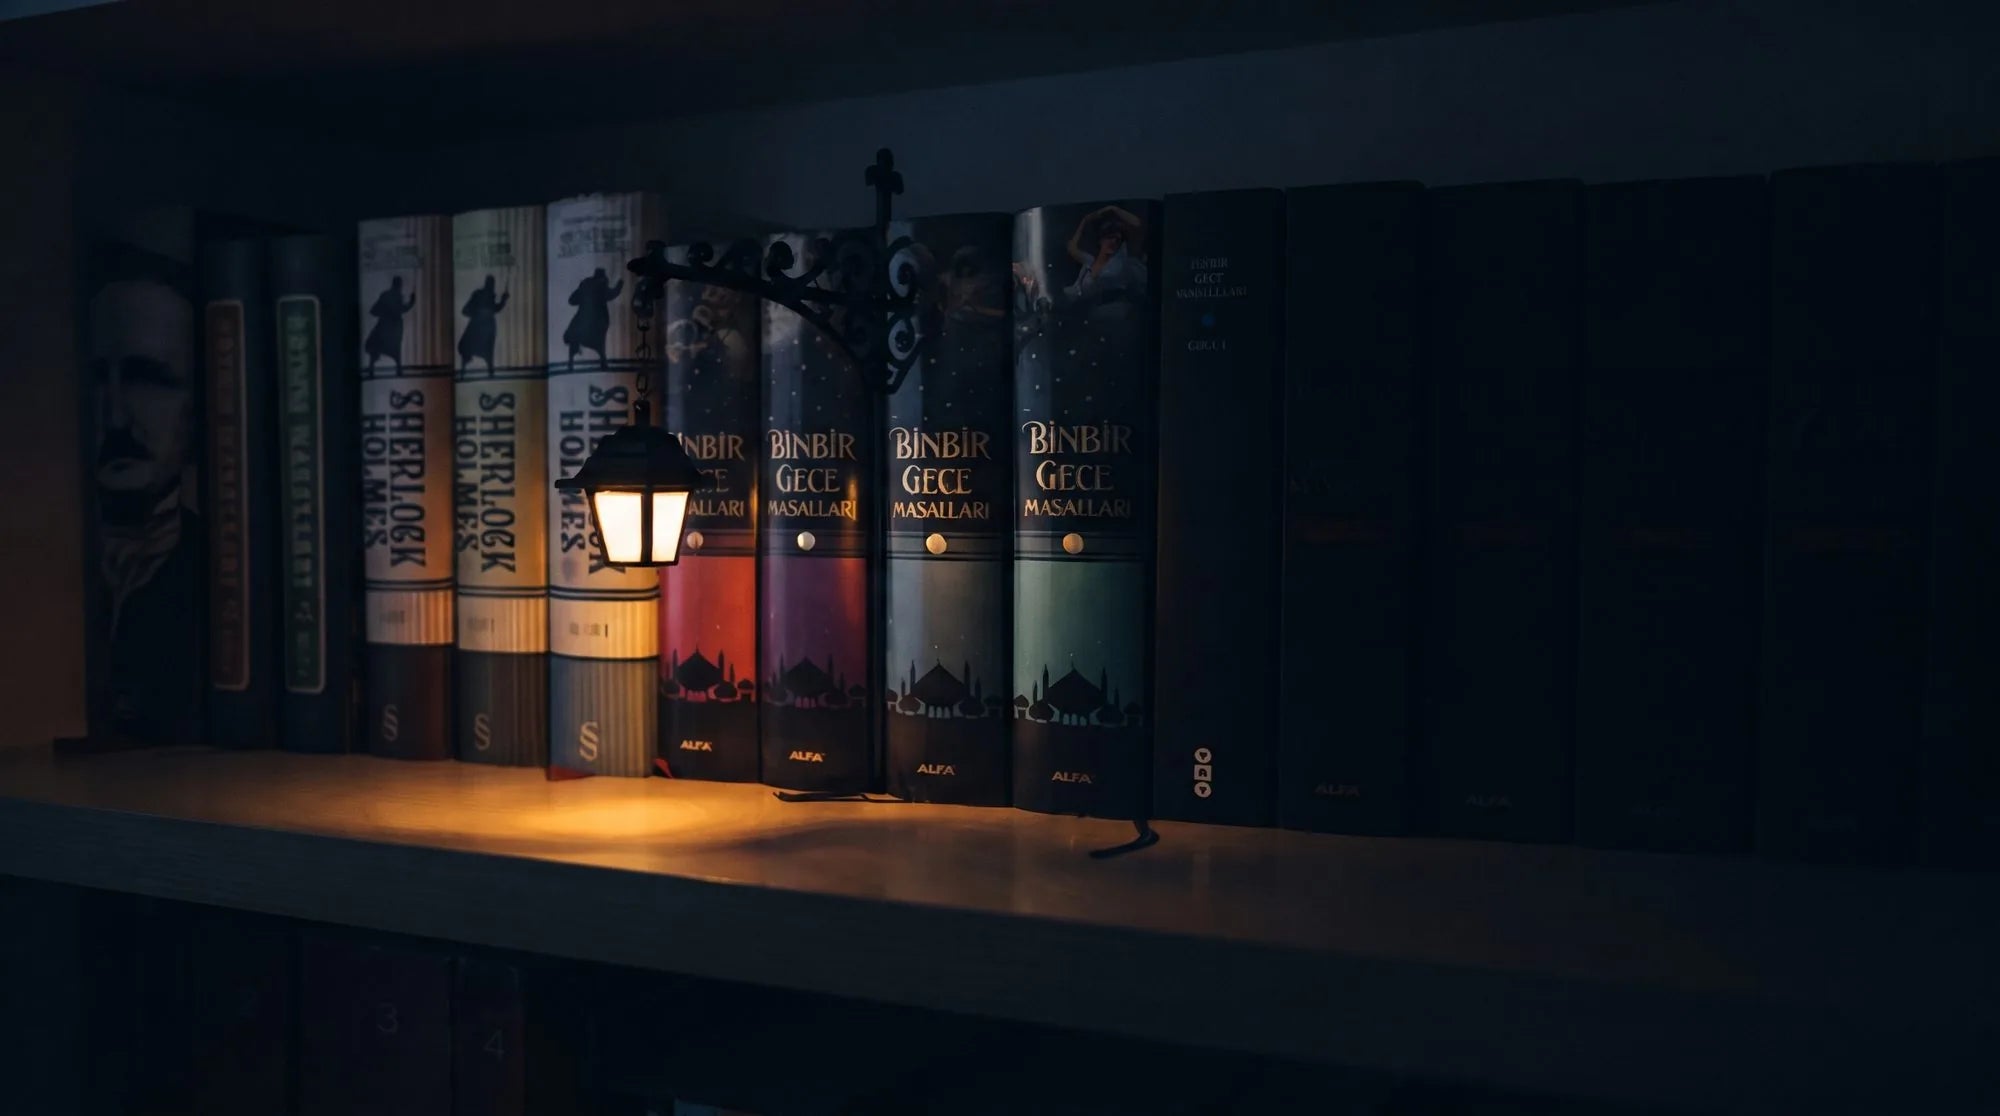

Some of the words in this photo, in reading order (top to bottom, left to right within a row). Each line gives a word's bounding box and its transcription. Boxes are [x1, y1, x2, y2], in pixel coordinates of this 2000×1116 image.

[768, 428, 857, 461] BİNBİR
[889, 426, 993, 461] BİNBİR
[1022, 420, 1136, 456] BİNBİR
[362, 413, 388, 549] HOLMES
[390, 389, 426, 568] SHERLOCK
[456, 416, 479, 552] HOLMES
[479, 392, 516, 573] SHERLOCK
[775, 463, 841, 494] GECE
[901, 464, 973, 495] GECE
[1035, 459, 1115, 492] GECE
[688, 499, 745, 518] ALLARI
[768, 499, 857, 521] MASALLARI
[892, 501, 990, 520] MASALLARI
[1024, 498, 1132, 520] MASALLARI
[679, 740, 713, 752] ALFA
[789, 751, 824, 763] ALFA
[917, 763, 956, 776] ALFA
[1052, 771, 1093, 784] ALFA
[376, 1001, 399, 1035] 3
[483, 1029, 507, 1062] 4
